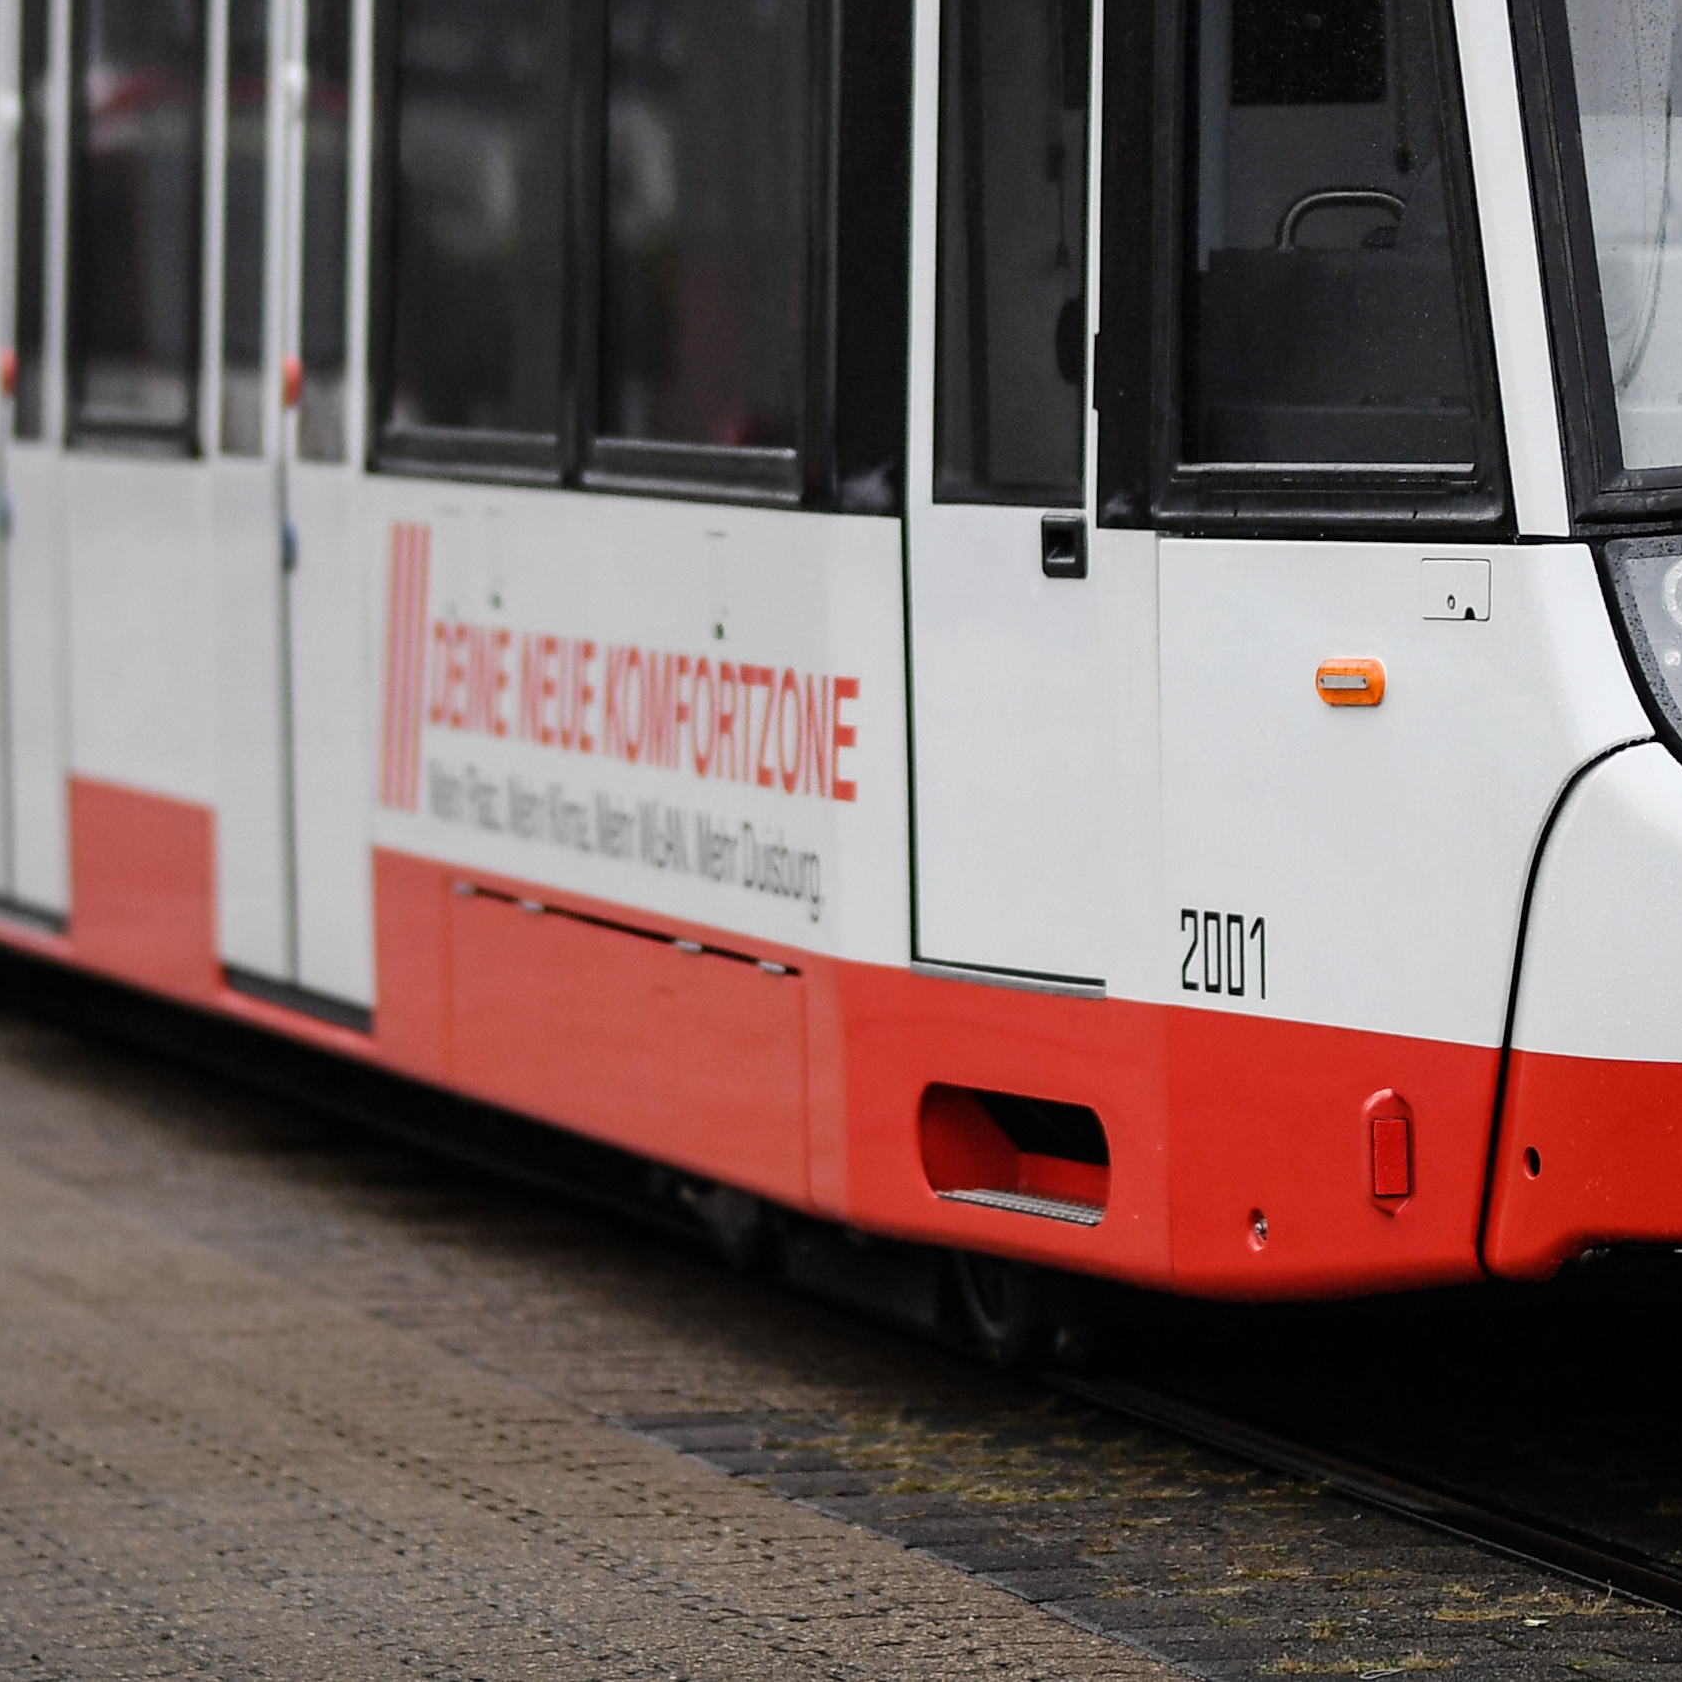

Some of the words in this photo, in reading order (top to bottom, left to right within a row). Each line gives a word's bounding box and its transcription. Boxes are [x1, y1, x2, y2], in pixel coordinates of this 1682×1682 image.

[430, 621, 511, 739] DEINE
[520, 632, 596, 753] NEUE
[604, 644, 860, 802] KOMFORTZONE
[1180, 908, 1267, 1000] 2001
